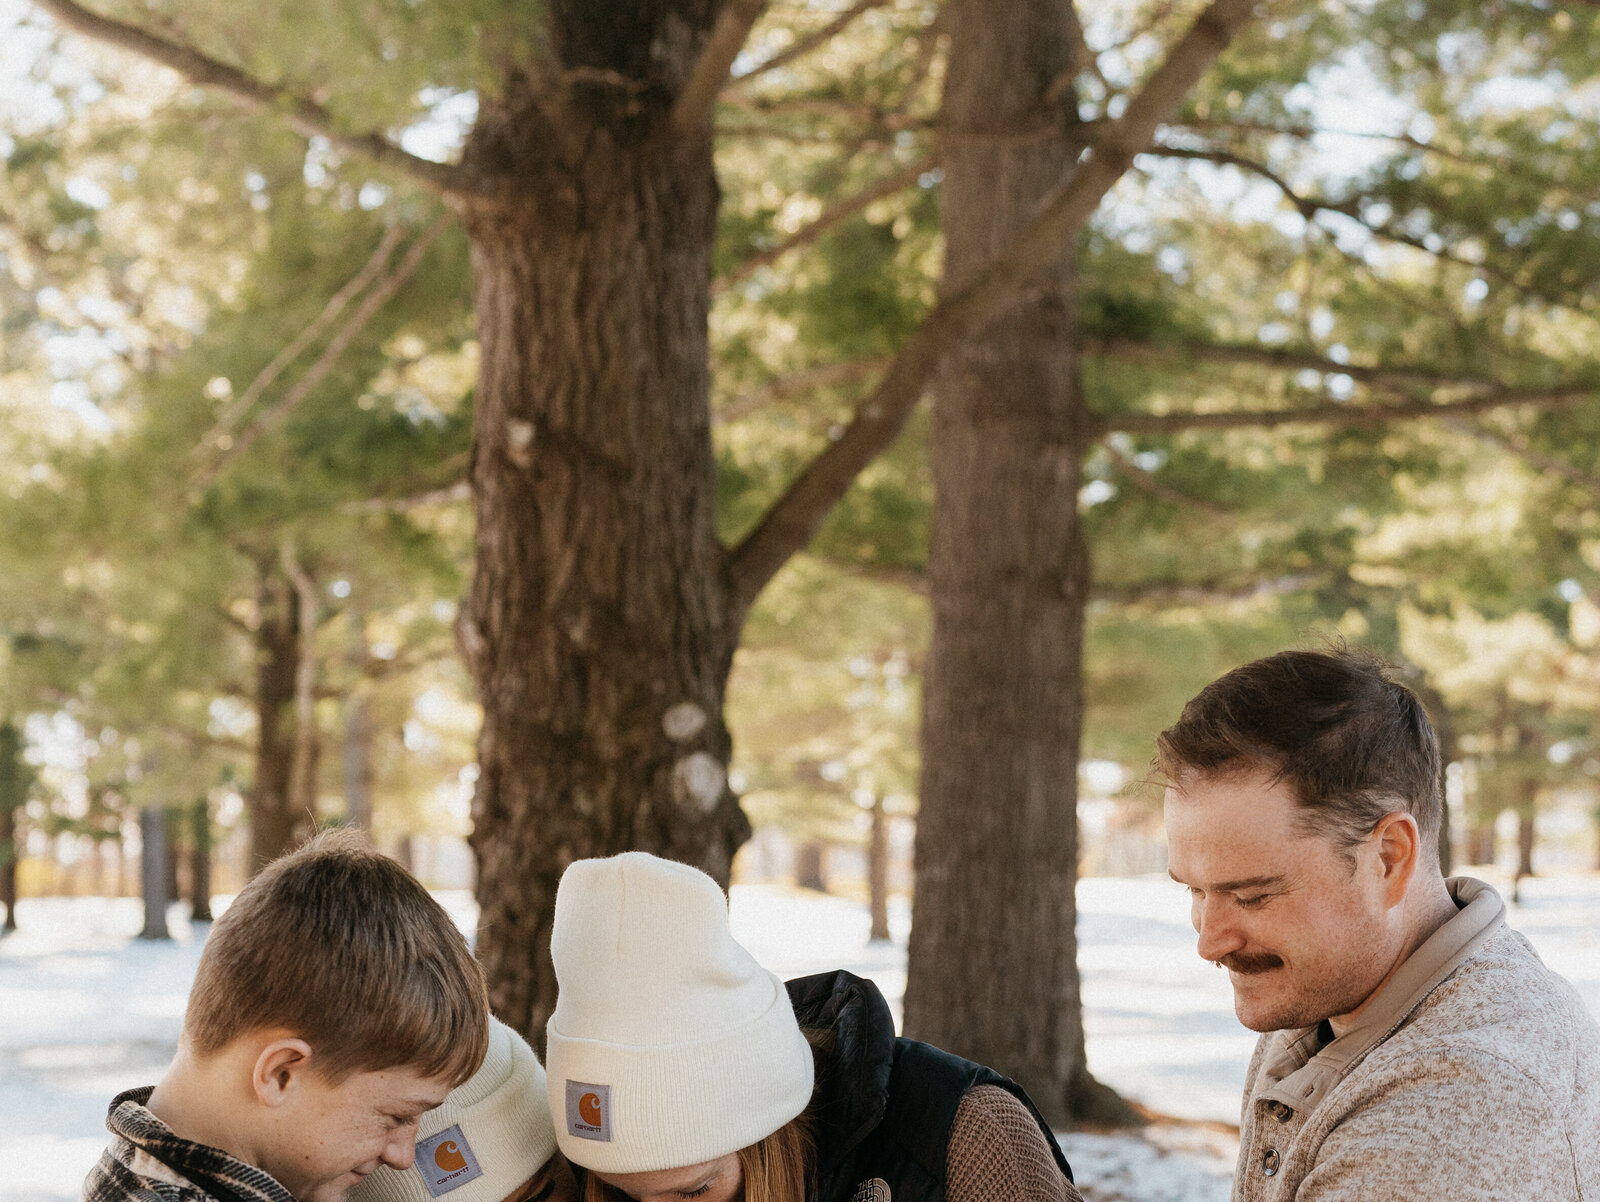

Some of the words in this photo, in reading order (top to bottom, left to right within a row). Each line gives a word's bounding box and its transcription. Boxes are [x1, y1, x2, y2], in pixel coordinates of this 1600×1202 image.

[574, 1123, 602, 1133] carhartt
[436, 1166, 469, 1185] carhartt
[858, 1178, 873, 1191] THE
